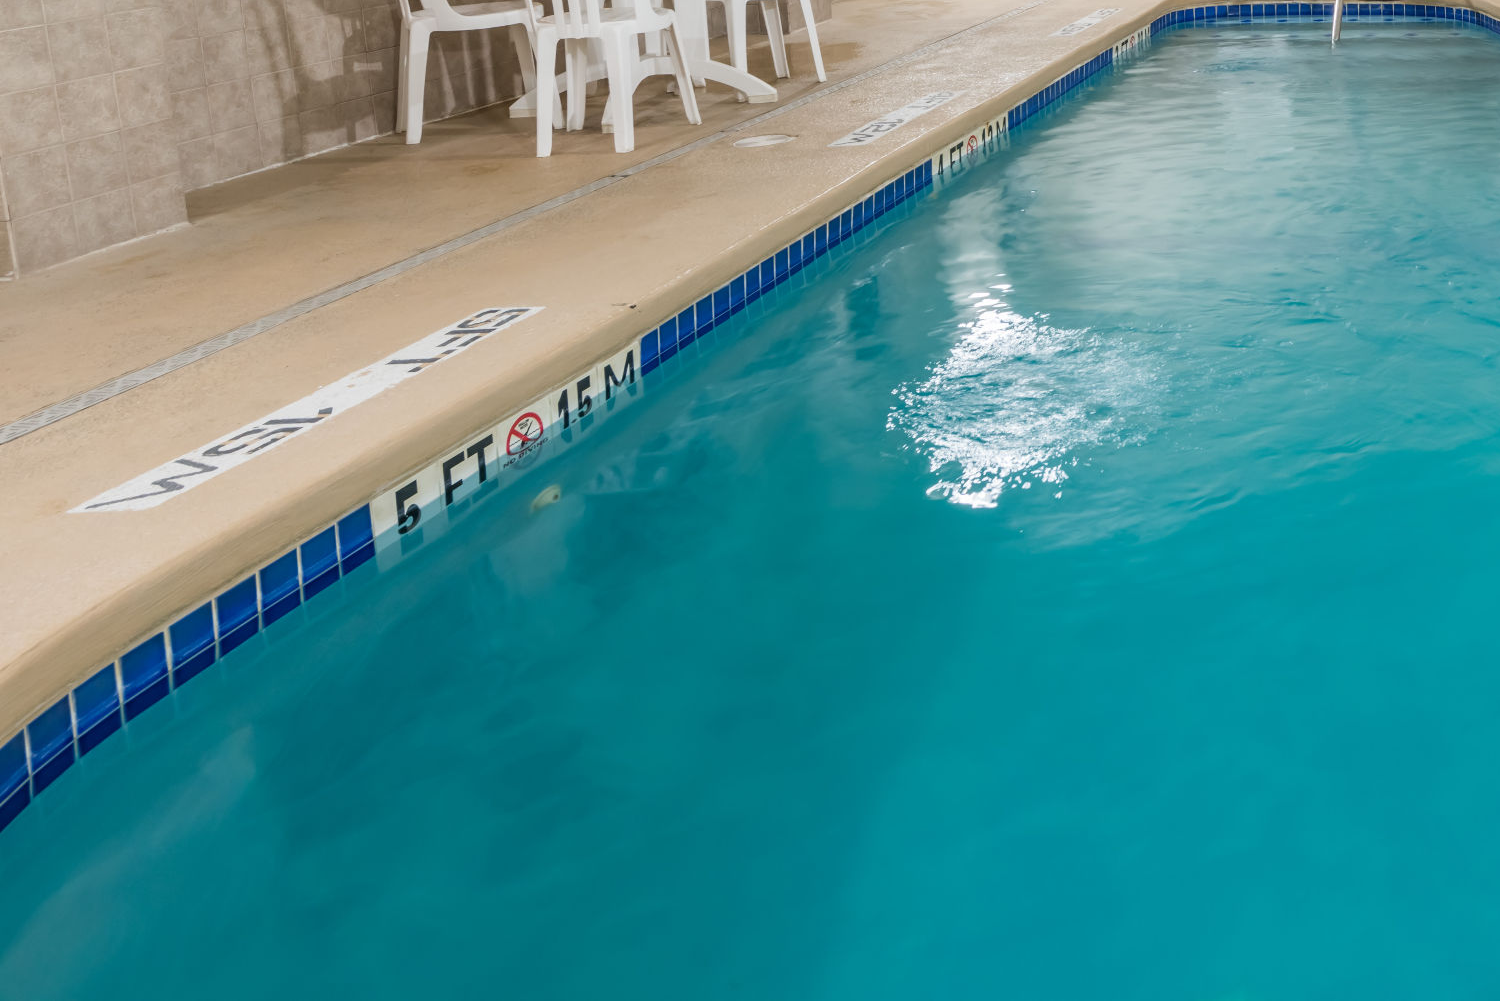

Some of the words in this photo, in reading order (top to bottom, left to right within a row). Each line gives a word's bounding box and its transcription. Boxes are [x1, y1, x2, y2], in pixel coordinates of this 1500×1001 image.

[950, 140, 964, 170] FT
[996, 116, 1006, 139] M
[395, 479, 421, 535] 5
[442, 433, 494, 507] FT
[557, 374, 593, 430] 1.5
[603, 349, 635, 401] M
[503, 457, 516, 469] NO
[518, 437, 549, 460] DIVING
